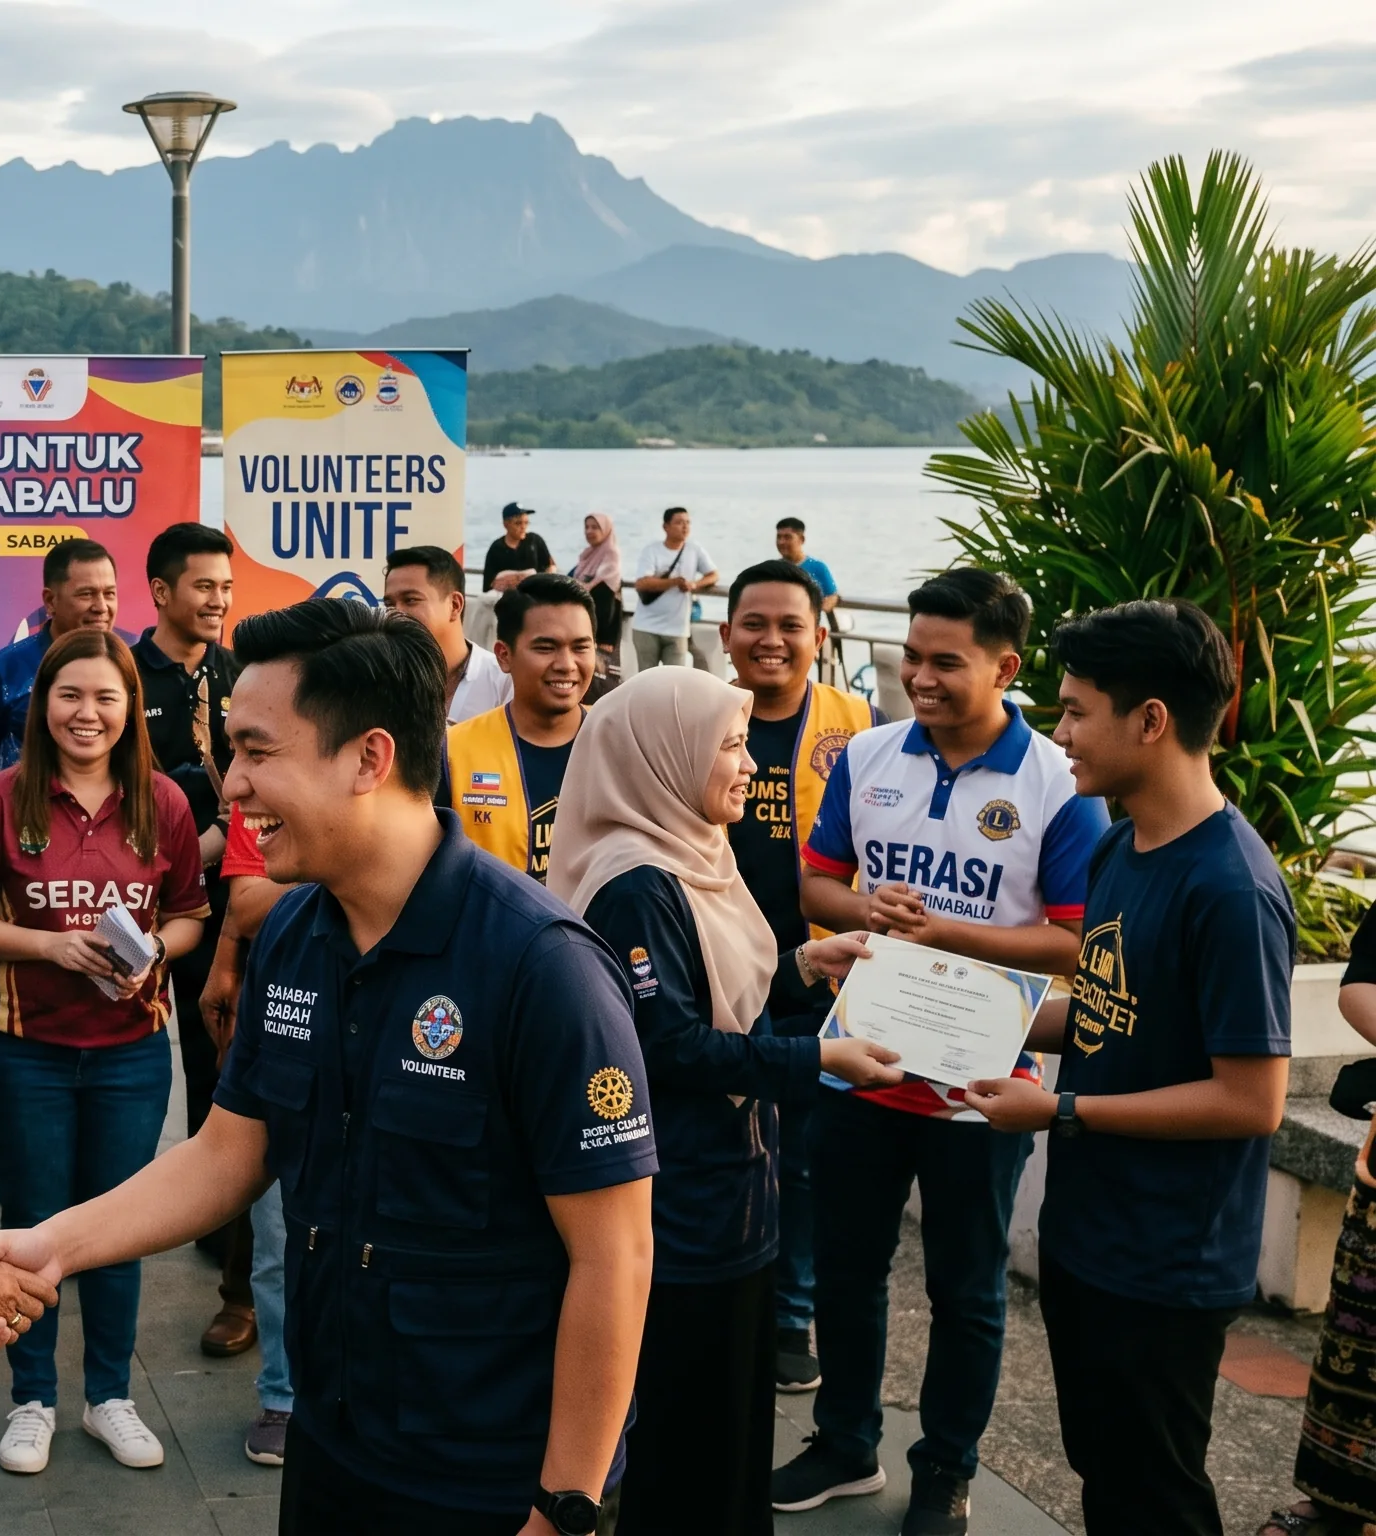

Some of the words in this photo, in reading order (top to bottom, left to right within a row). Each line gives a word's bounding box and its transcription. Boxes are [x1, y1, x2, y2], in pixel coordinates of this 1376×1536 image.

[239, 454, 446, 493] VOLUNTEERS
[474, 810, 492, 823] KK
[865, 840, 1004, 902] SERASI
[26, 880, 153, 910] SERASI
[266, 1001, 311, 1025] SABAH
[401, 1059, 466, 1081] VOLUNTEER
